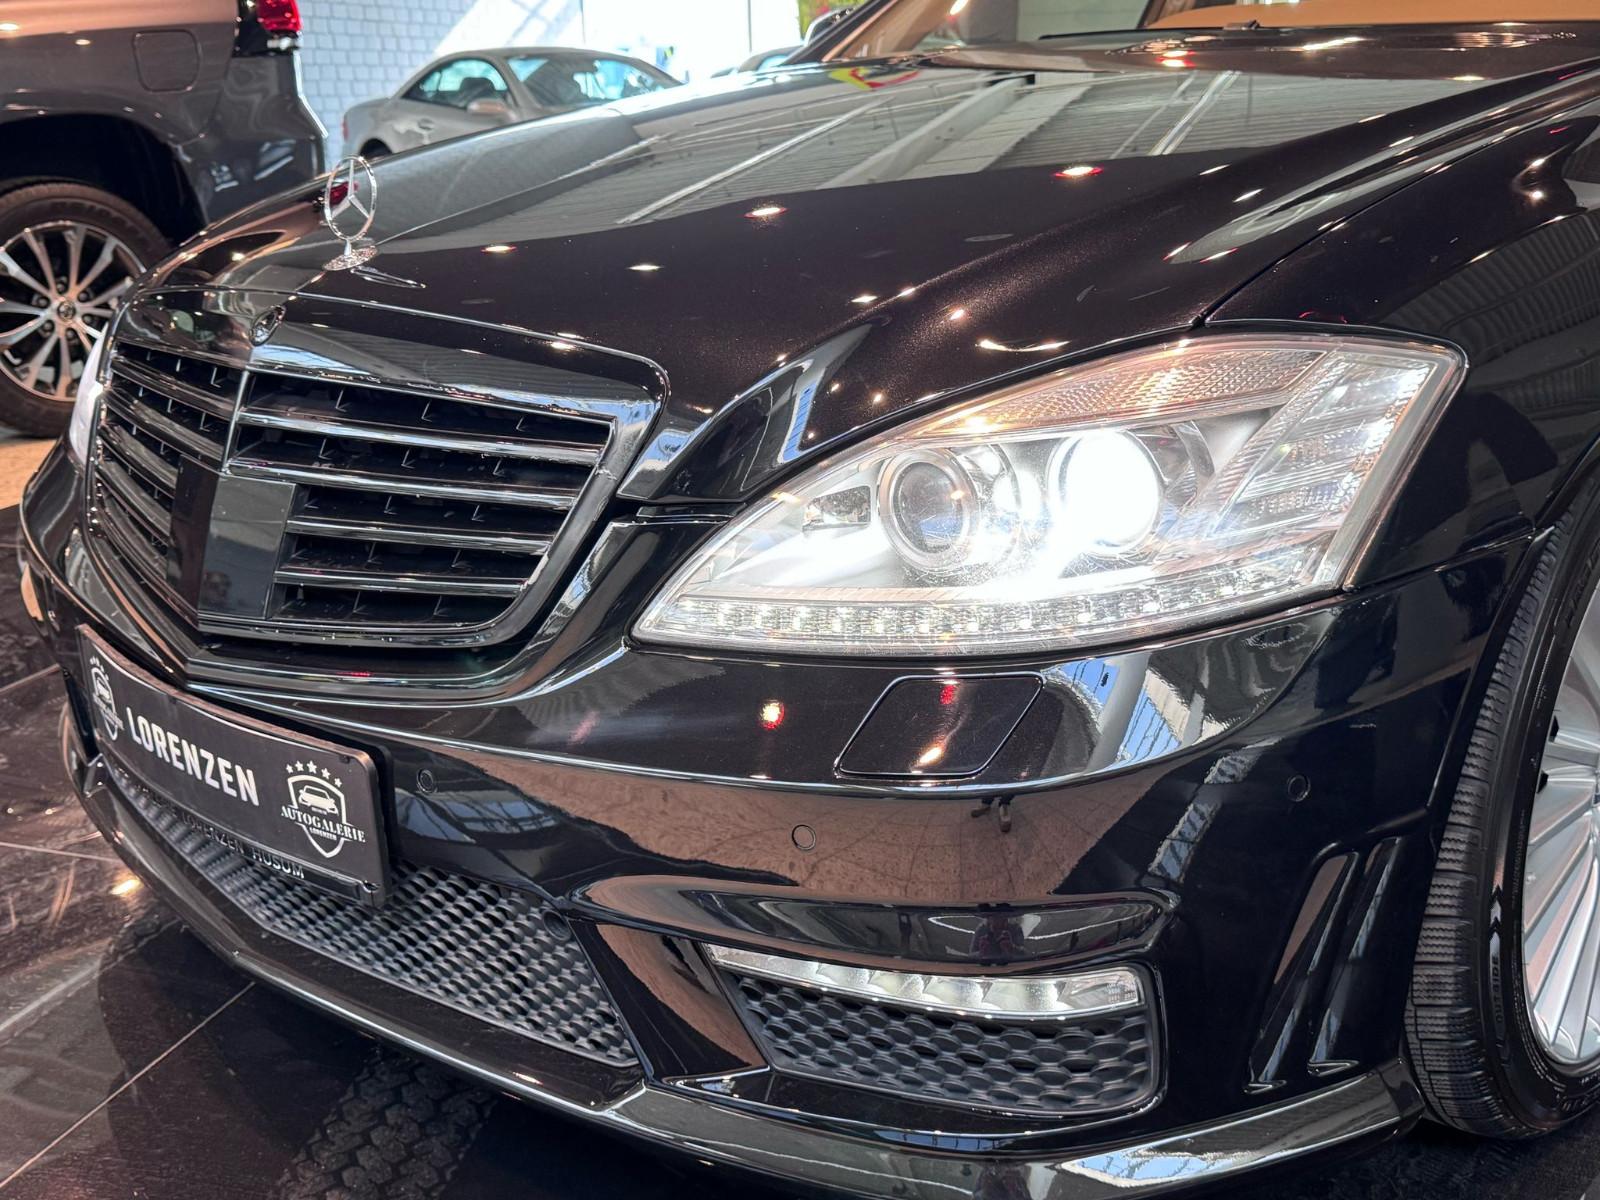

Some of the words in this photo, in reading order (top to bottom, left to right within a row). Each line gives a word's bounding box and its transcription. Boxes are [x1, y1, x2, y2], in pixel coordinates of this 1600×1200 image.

[126, 706, 260, 807] LORENZEN
[280, 805, 366, 843] AUTOGALERIE
[252, 846, 305, 879] HUSUM
